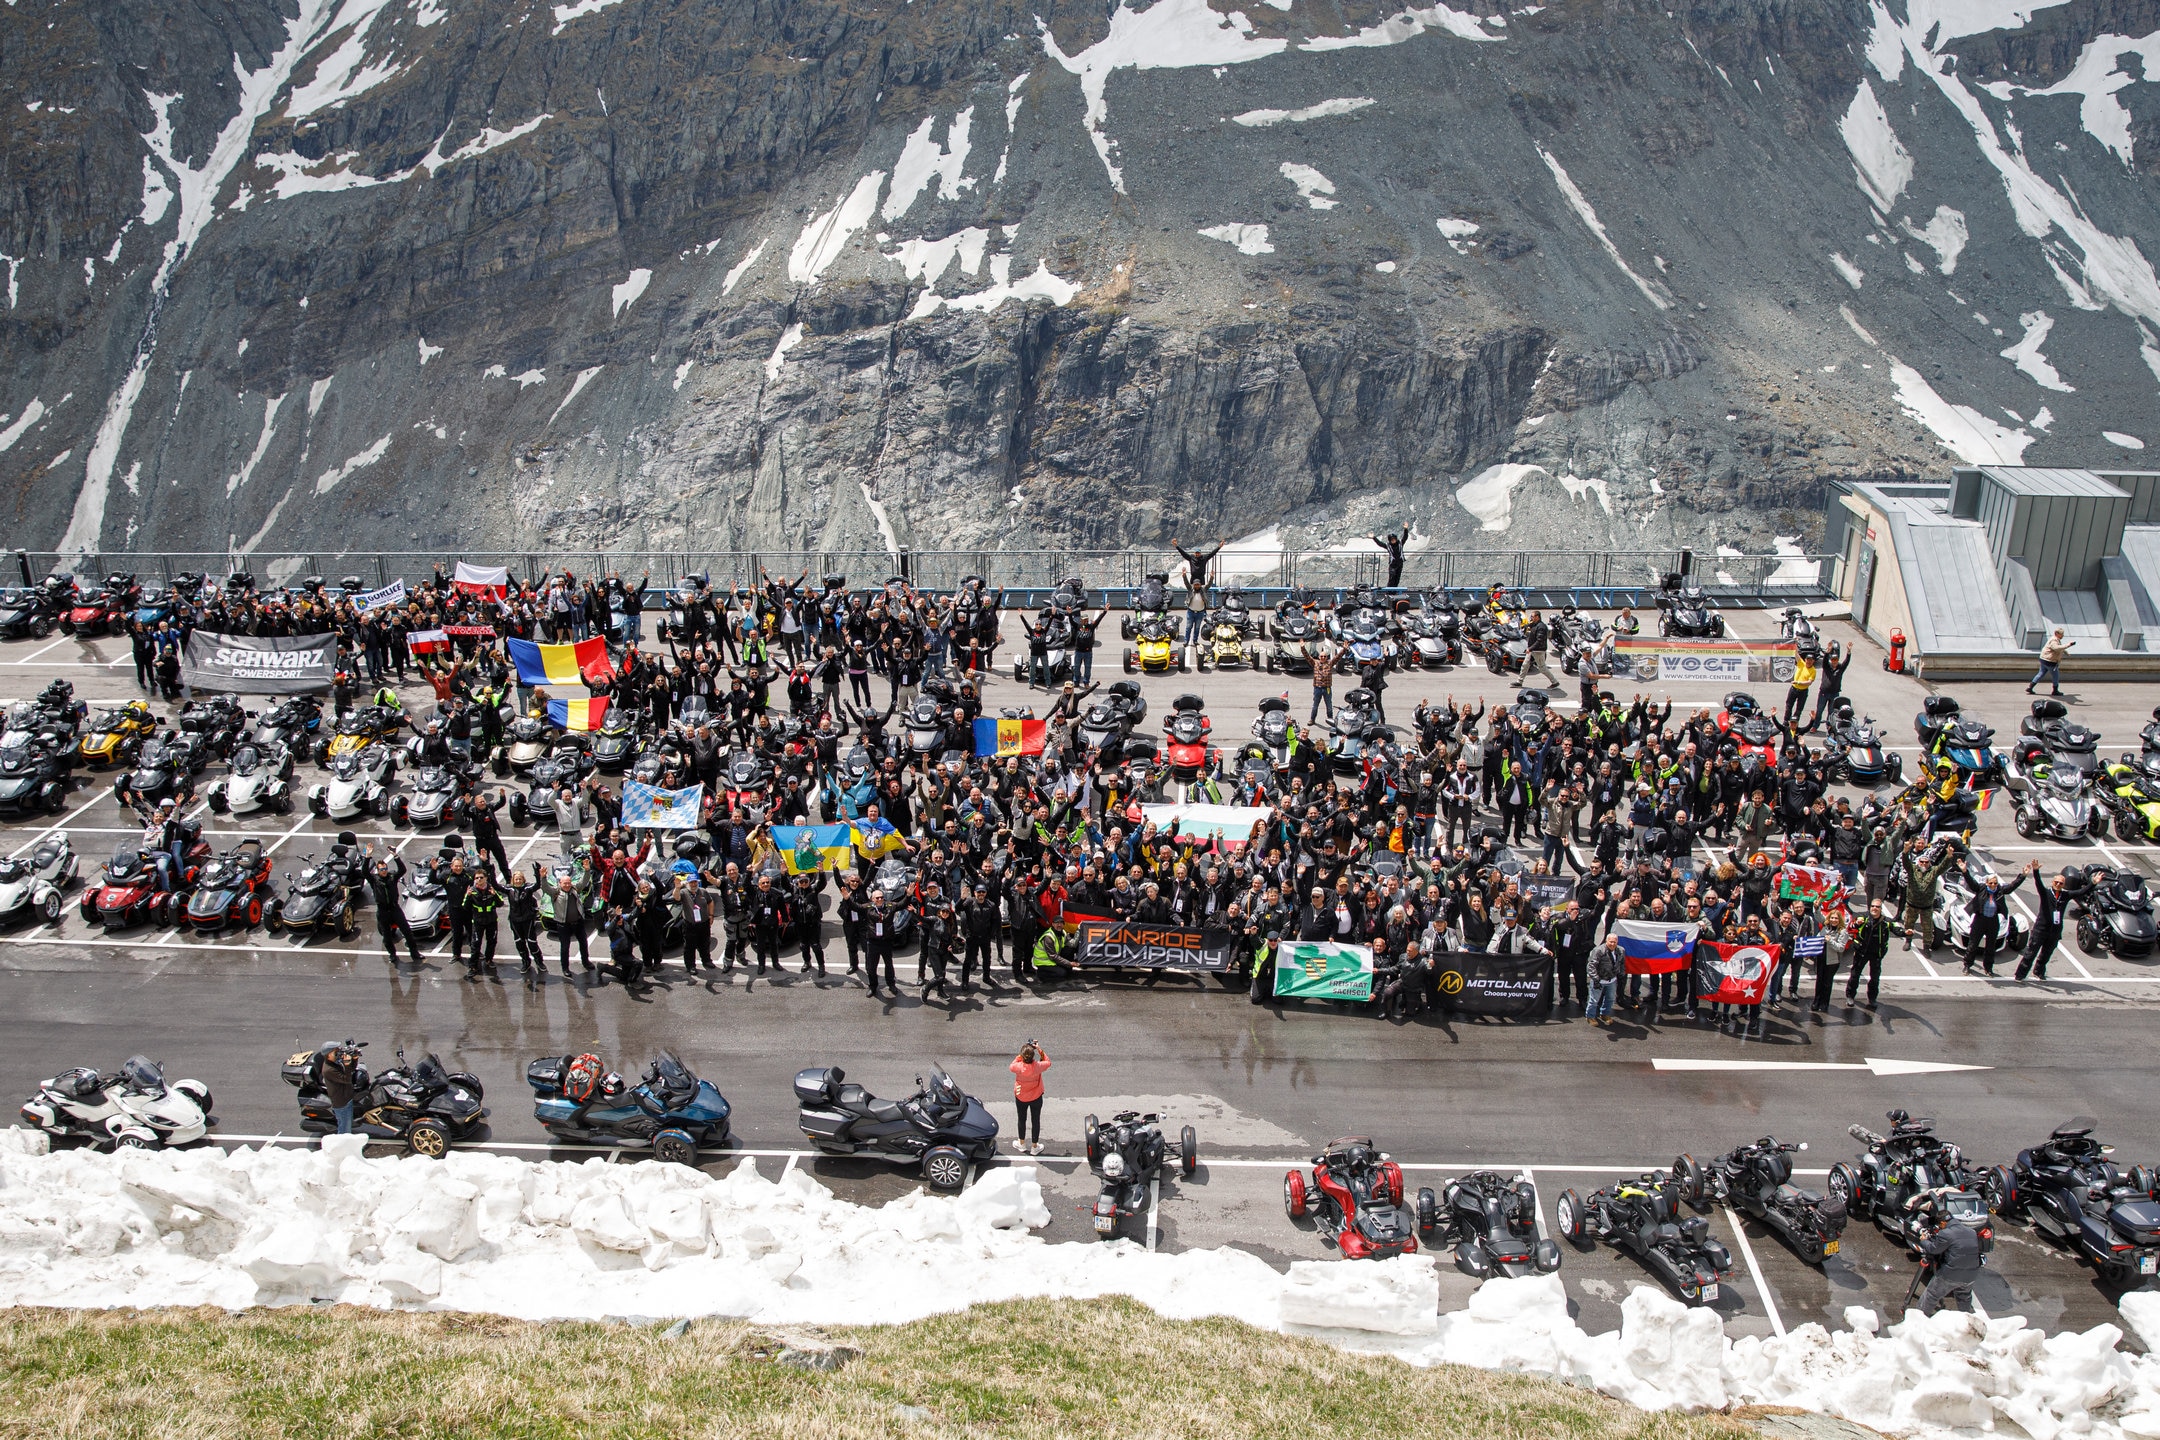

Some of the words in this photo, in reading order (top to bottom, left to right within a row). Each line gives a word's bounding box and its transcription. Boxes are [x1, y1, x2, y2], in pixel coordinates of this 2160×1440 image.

[367, 583, 402, 601] GORLICE
[1662, 656, 1742, 672] VOGT
[232, 668, 303, 679] POWERSPORT
[1087, 928, 1203, 949] FUNRIDE
[1086, 943, 1222, 966] COMPANY
[1466, 980, 1541, 990] MOTOLAND
